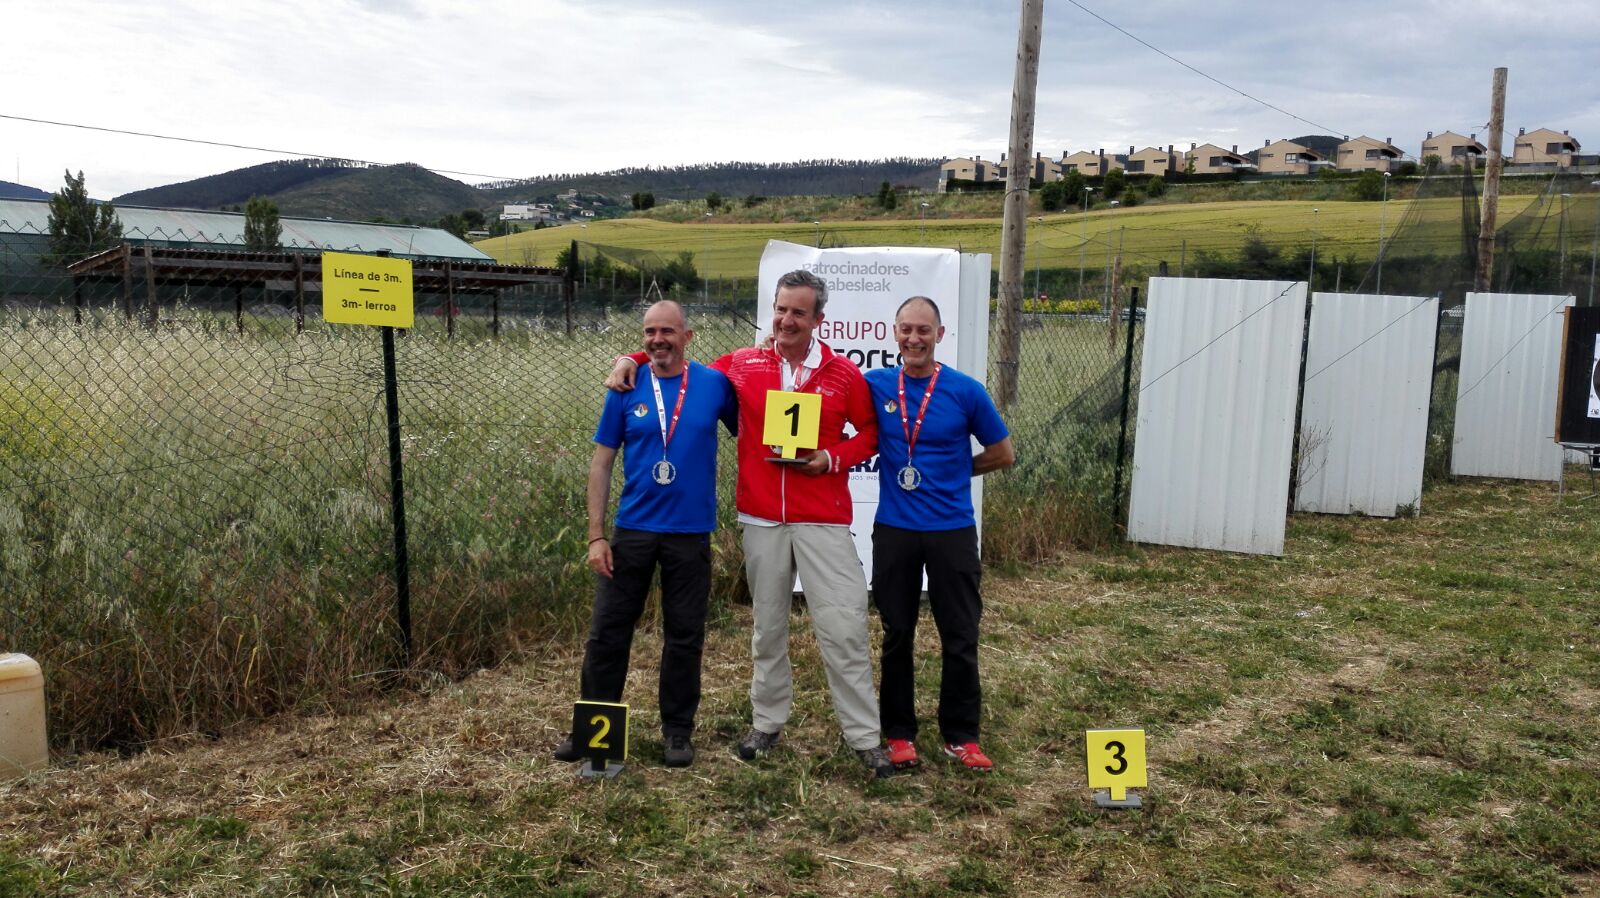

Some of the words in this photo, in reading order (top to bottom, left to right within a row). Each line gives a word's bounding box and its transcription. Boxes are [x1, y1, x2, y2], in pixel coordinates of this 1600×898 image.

[334, 268, 364, 280] Línea
[367, 272, 380, 281] de
[383, 273, 402, 283] 3m.
[341, 299, 362, 308] 3m-
[365, 300, 396, 311] lerroa
[818, 321, 886, 341] GRUPO
[784, 403, 800, 437] 1
[588, 714, 611, 749] 2
[1104, 740, 1128, 776] 3
